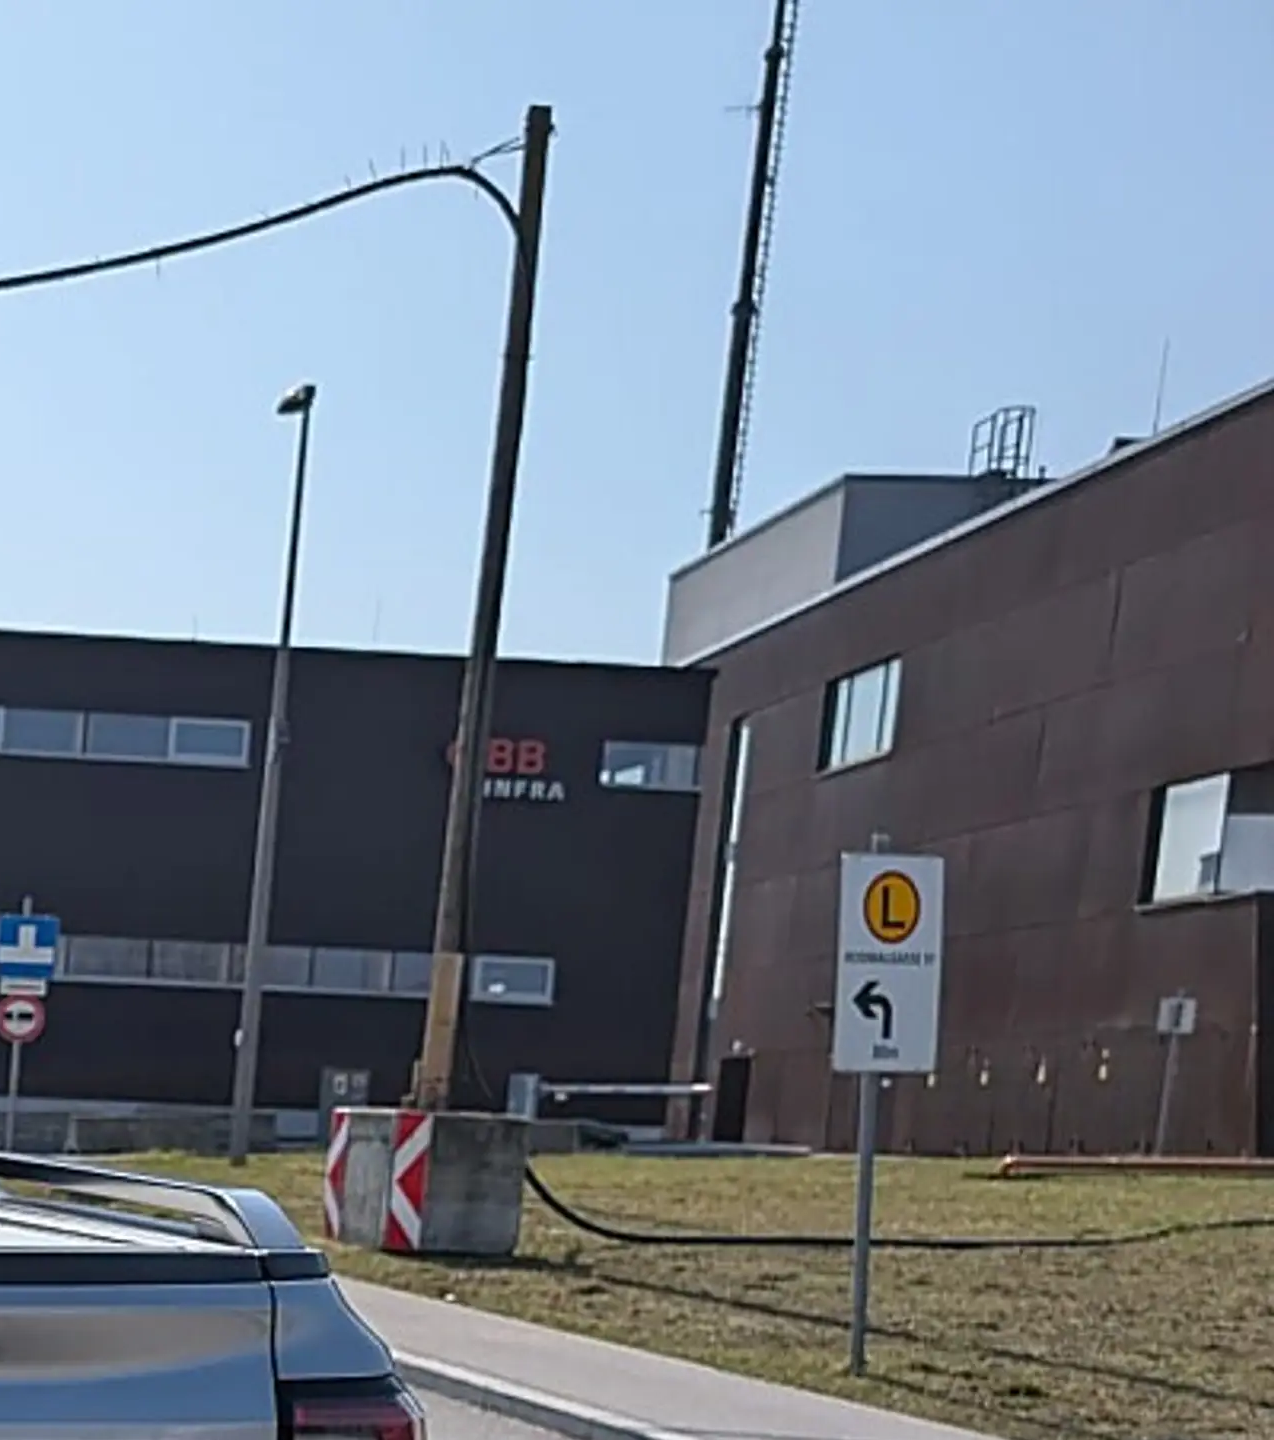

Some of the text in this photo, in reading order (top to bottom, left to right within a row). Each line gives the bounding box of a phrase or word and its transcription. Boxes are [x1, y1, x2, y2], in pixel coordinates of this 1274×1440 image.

[447, 738, 546, 773] BB
[483, 778, 565, 800] INFRA
[882, 885, 905, 928] L
